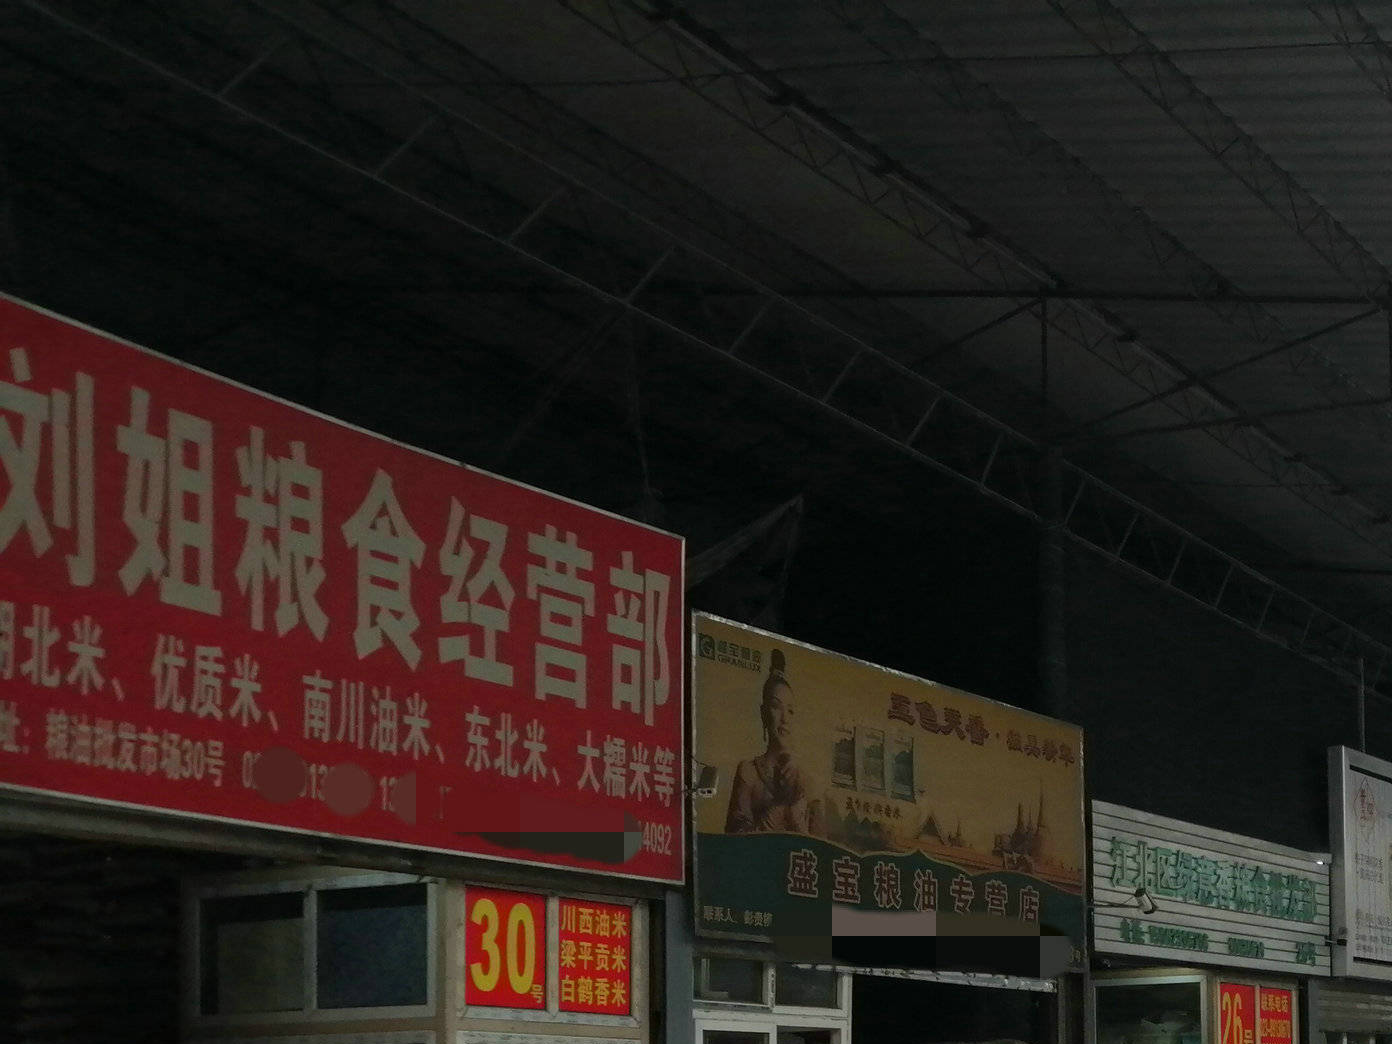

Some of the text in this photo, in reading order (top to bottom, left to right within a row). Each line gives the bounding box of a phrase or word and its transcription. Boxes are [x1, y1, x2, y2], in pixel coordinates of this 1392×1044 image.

[0, 347, 672, 727] 刘姐粮食经营部
[560, 904, 628, 939] 川西油米
[560, 939, 628, 974] 梁平贡米
[560, 974, 628, 1008] 白鹤香米
